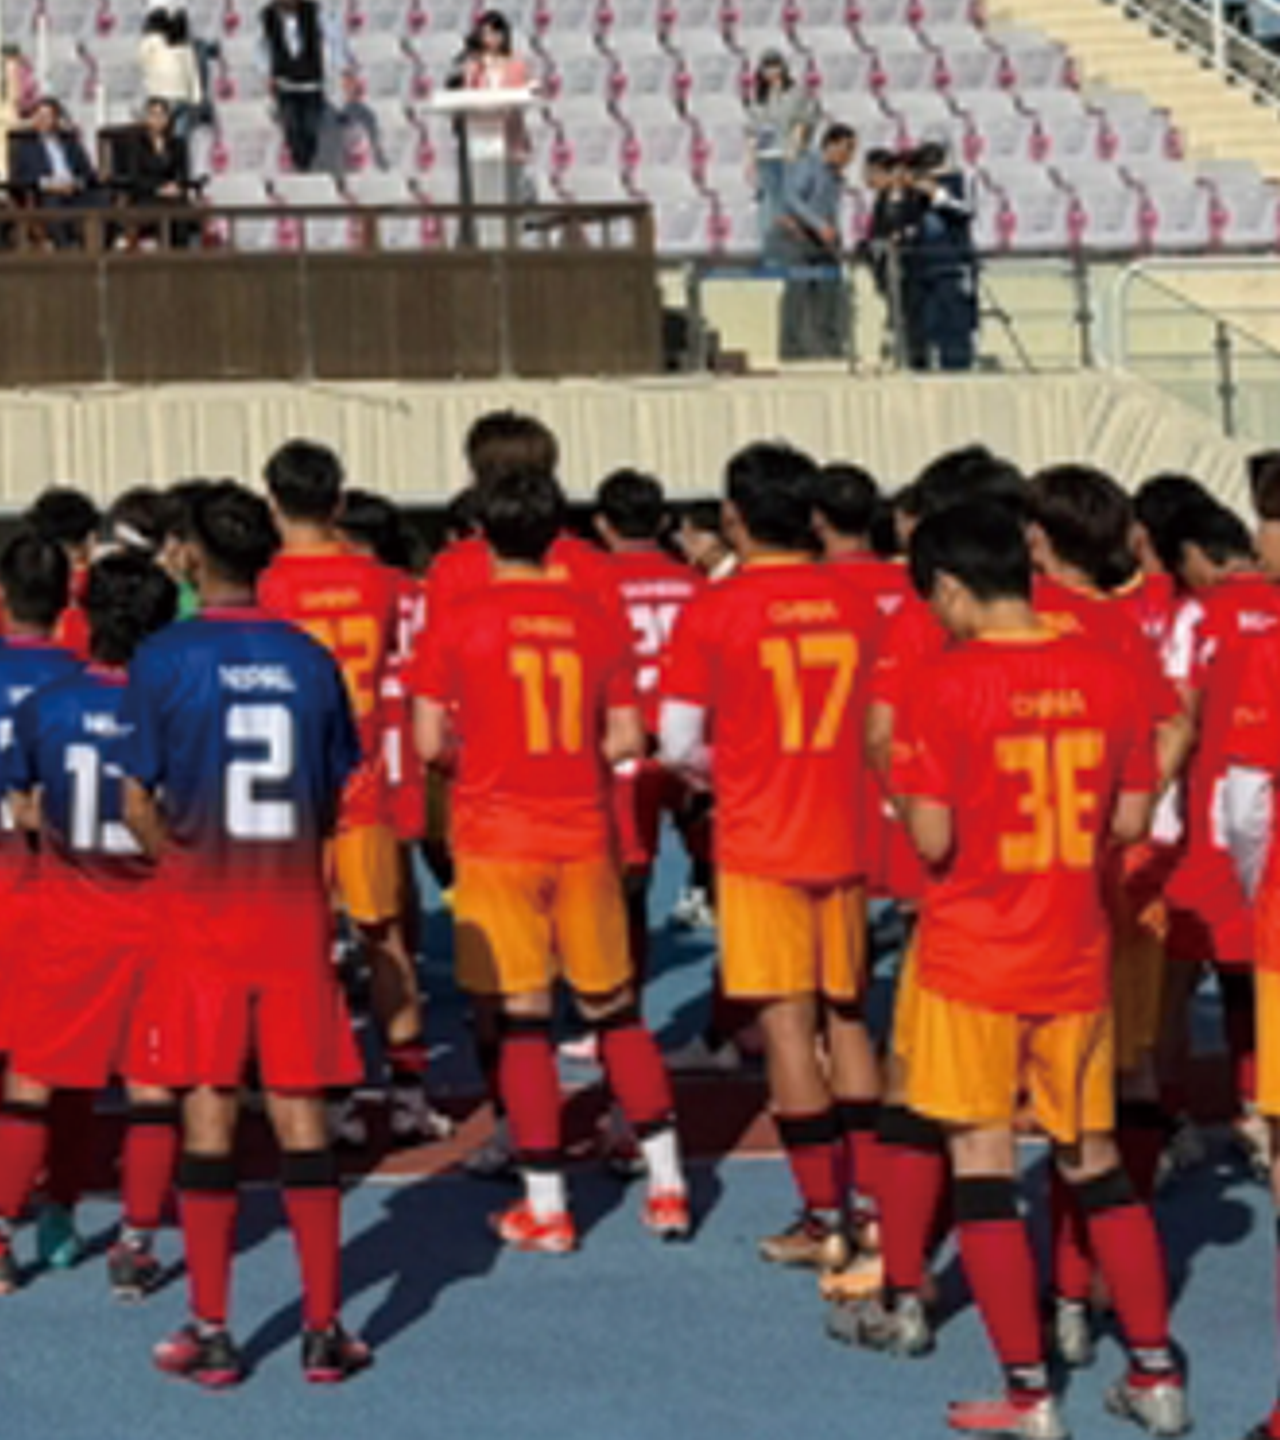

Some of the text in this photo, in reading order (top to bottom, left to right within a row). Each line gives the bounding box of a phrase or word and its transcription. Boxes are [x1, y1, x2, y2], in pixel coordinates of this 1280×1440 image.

[509, 646, 582, 753] 11
[759, 633, 858, 751] 17
[227, 703, 293, 839] 2
